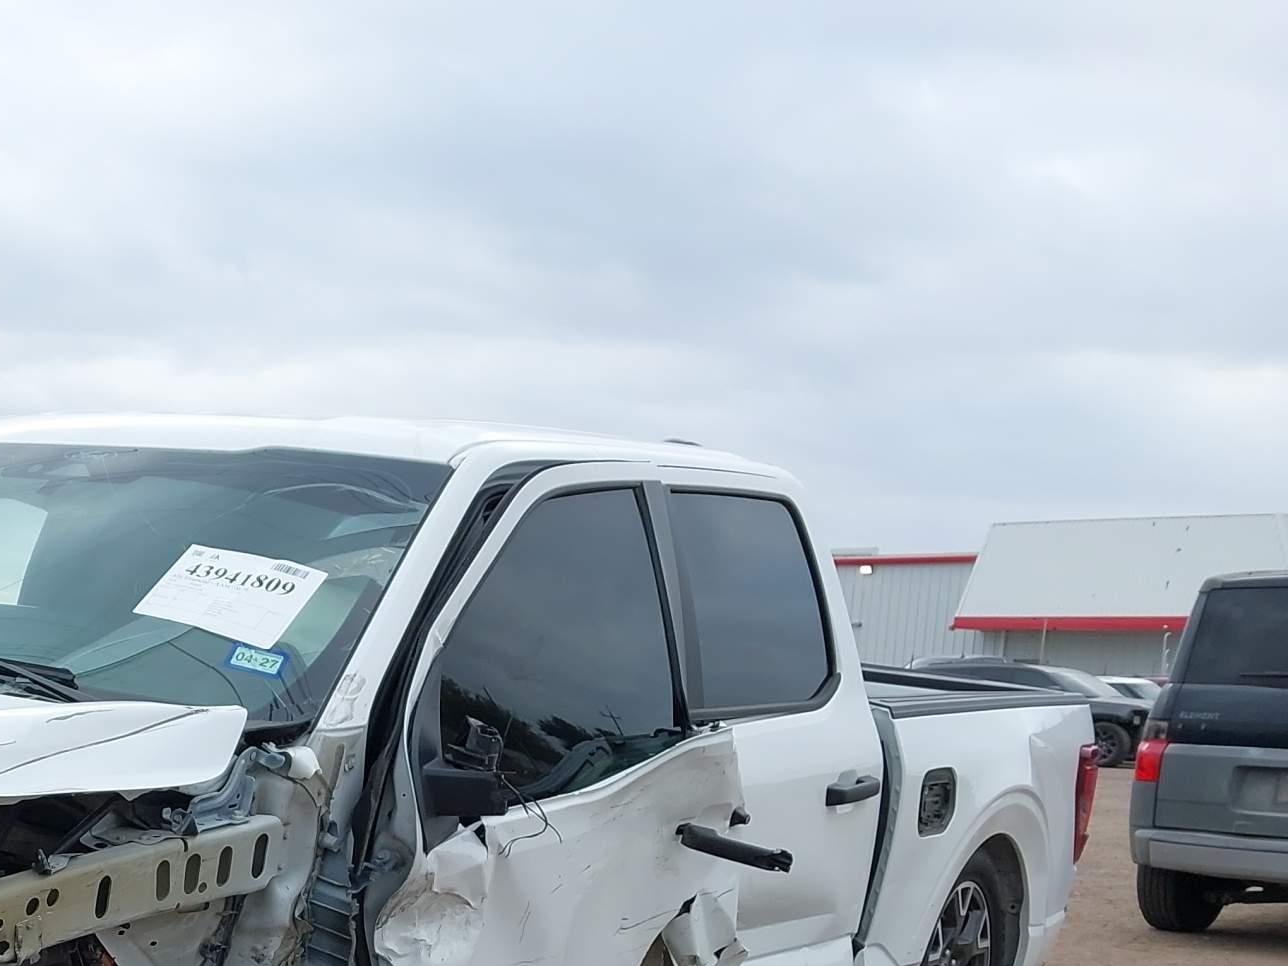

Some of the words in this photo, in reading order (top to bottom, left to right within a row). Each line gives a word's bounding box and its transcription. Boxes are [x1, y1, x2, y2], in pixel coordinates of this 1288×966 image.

[185, 563, 296, 596] 43941809
[235, 651, 254, 664] 04
[258, 657, 280, 669] 27
